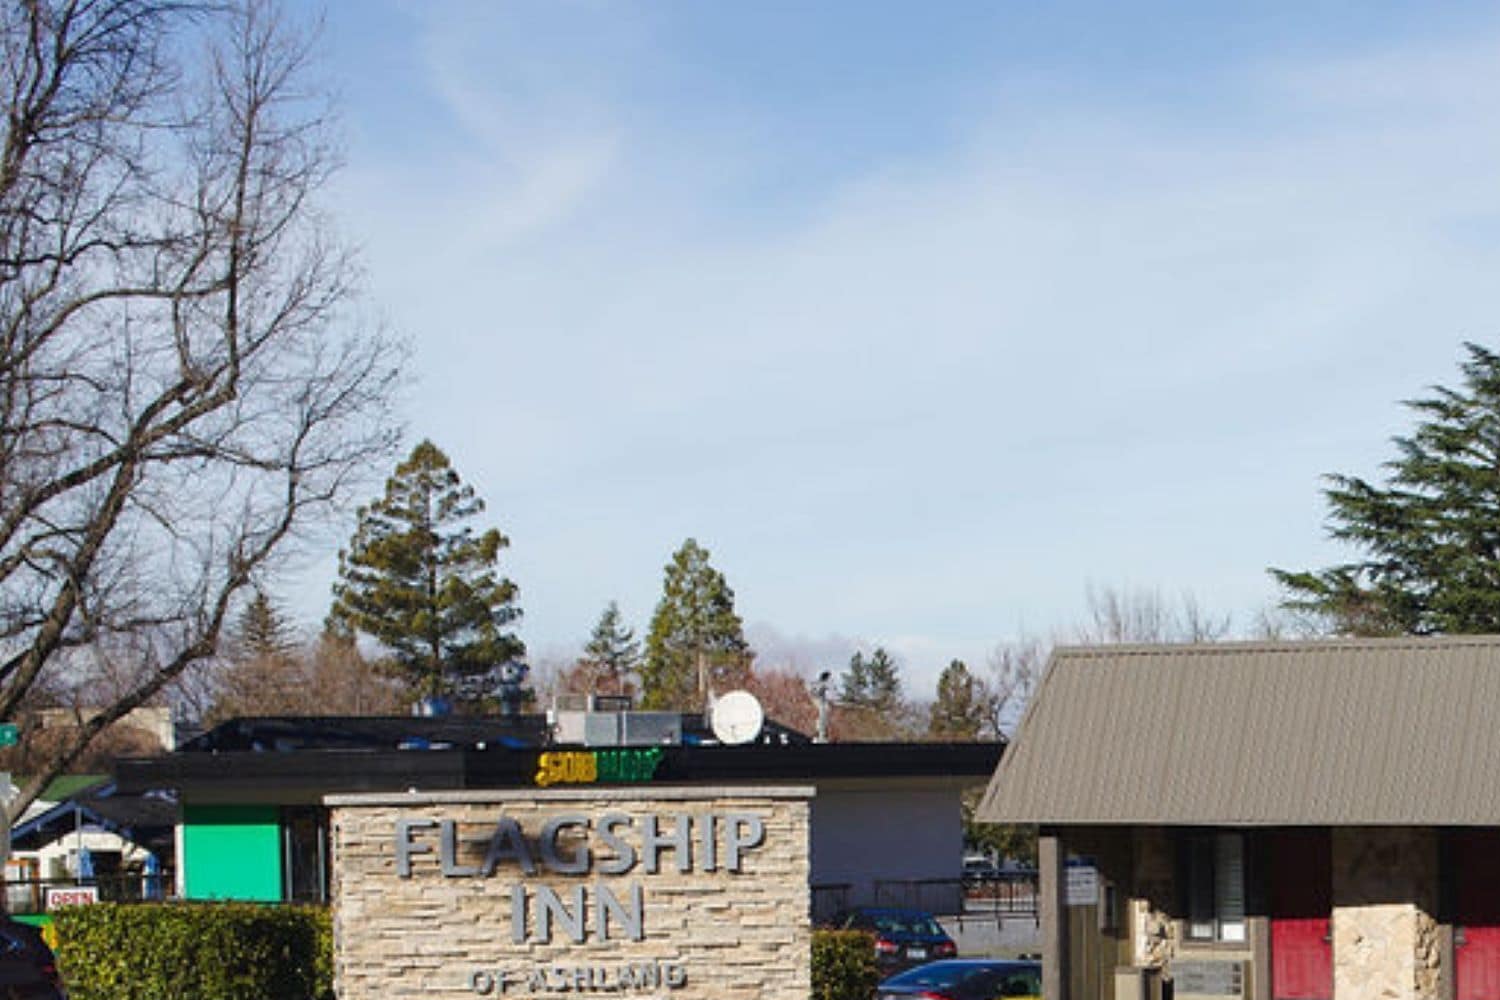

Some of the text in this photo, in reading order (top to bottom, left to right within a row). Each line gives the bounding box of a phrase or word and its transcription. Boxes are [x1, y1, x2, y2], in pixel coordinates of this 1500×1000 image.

[396, 813, 766, 877] FLAGSHIP
[511, 882, 646, 945] INN
[468, 959, 689, 994] OF ASHLAND
